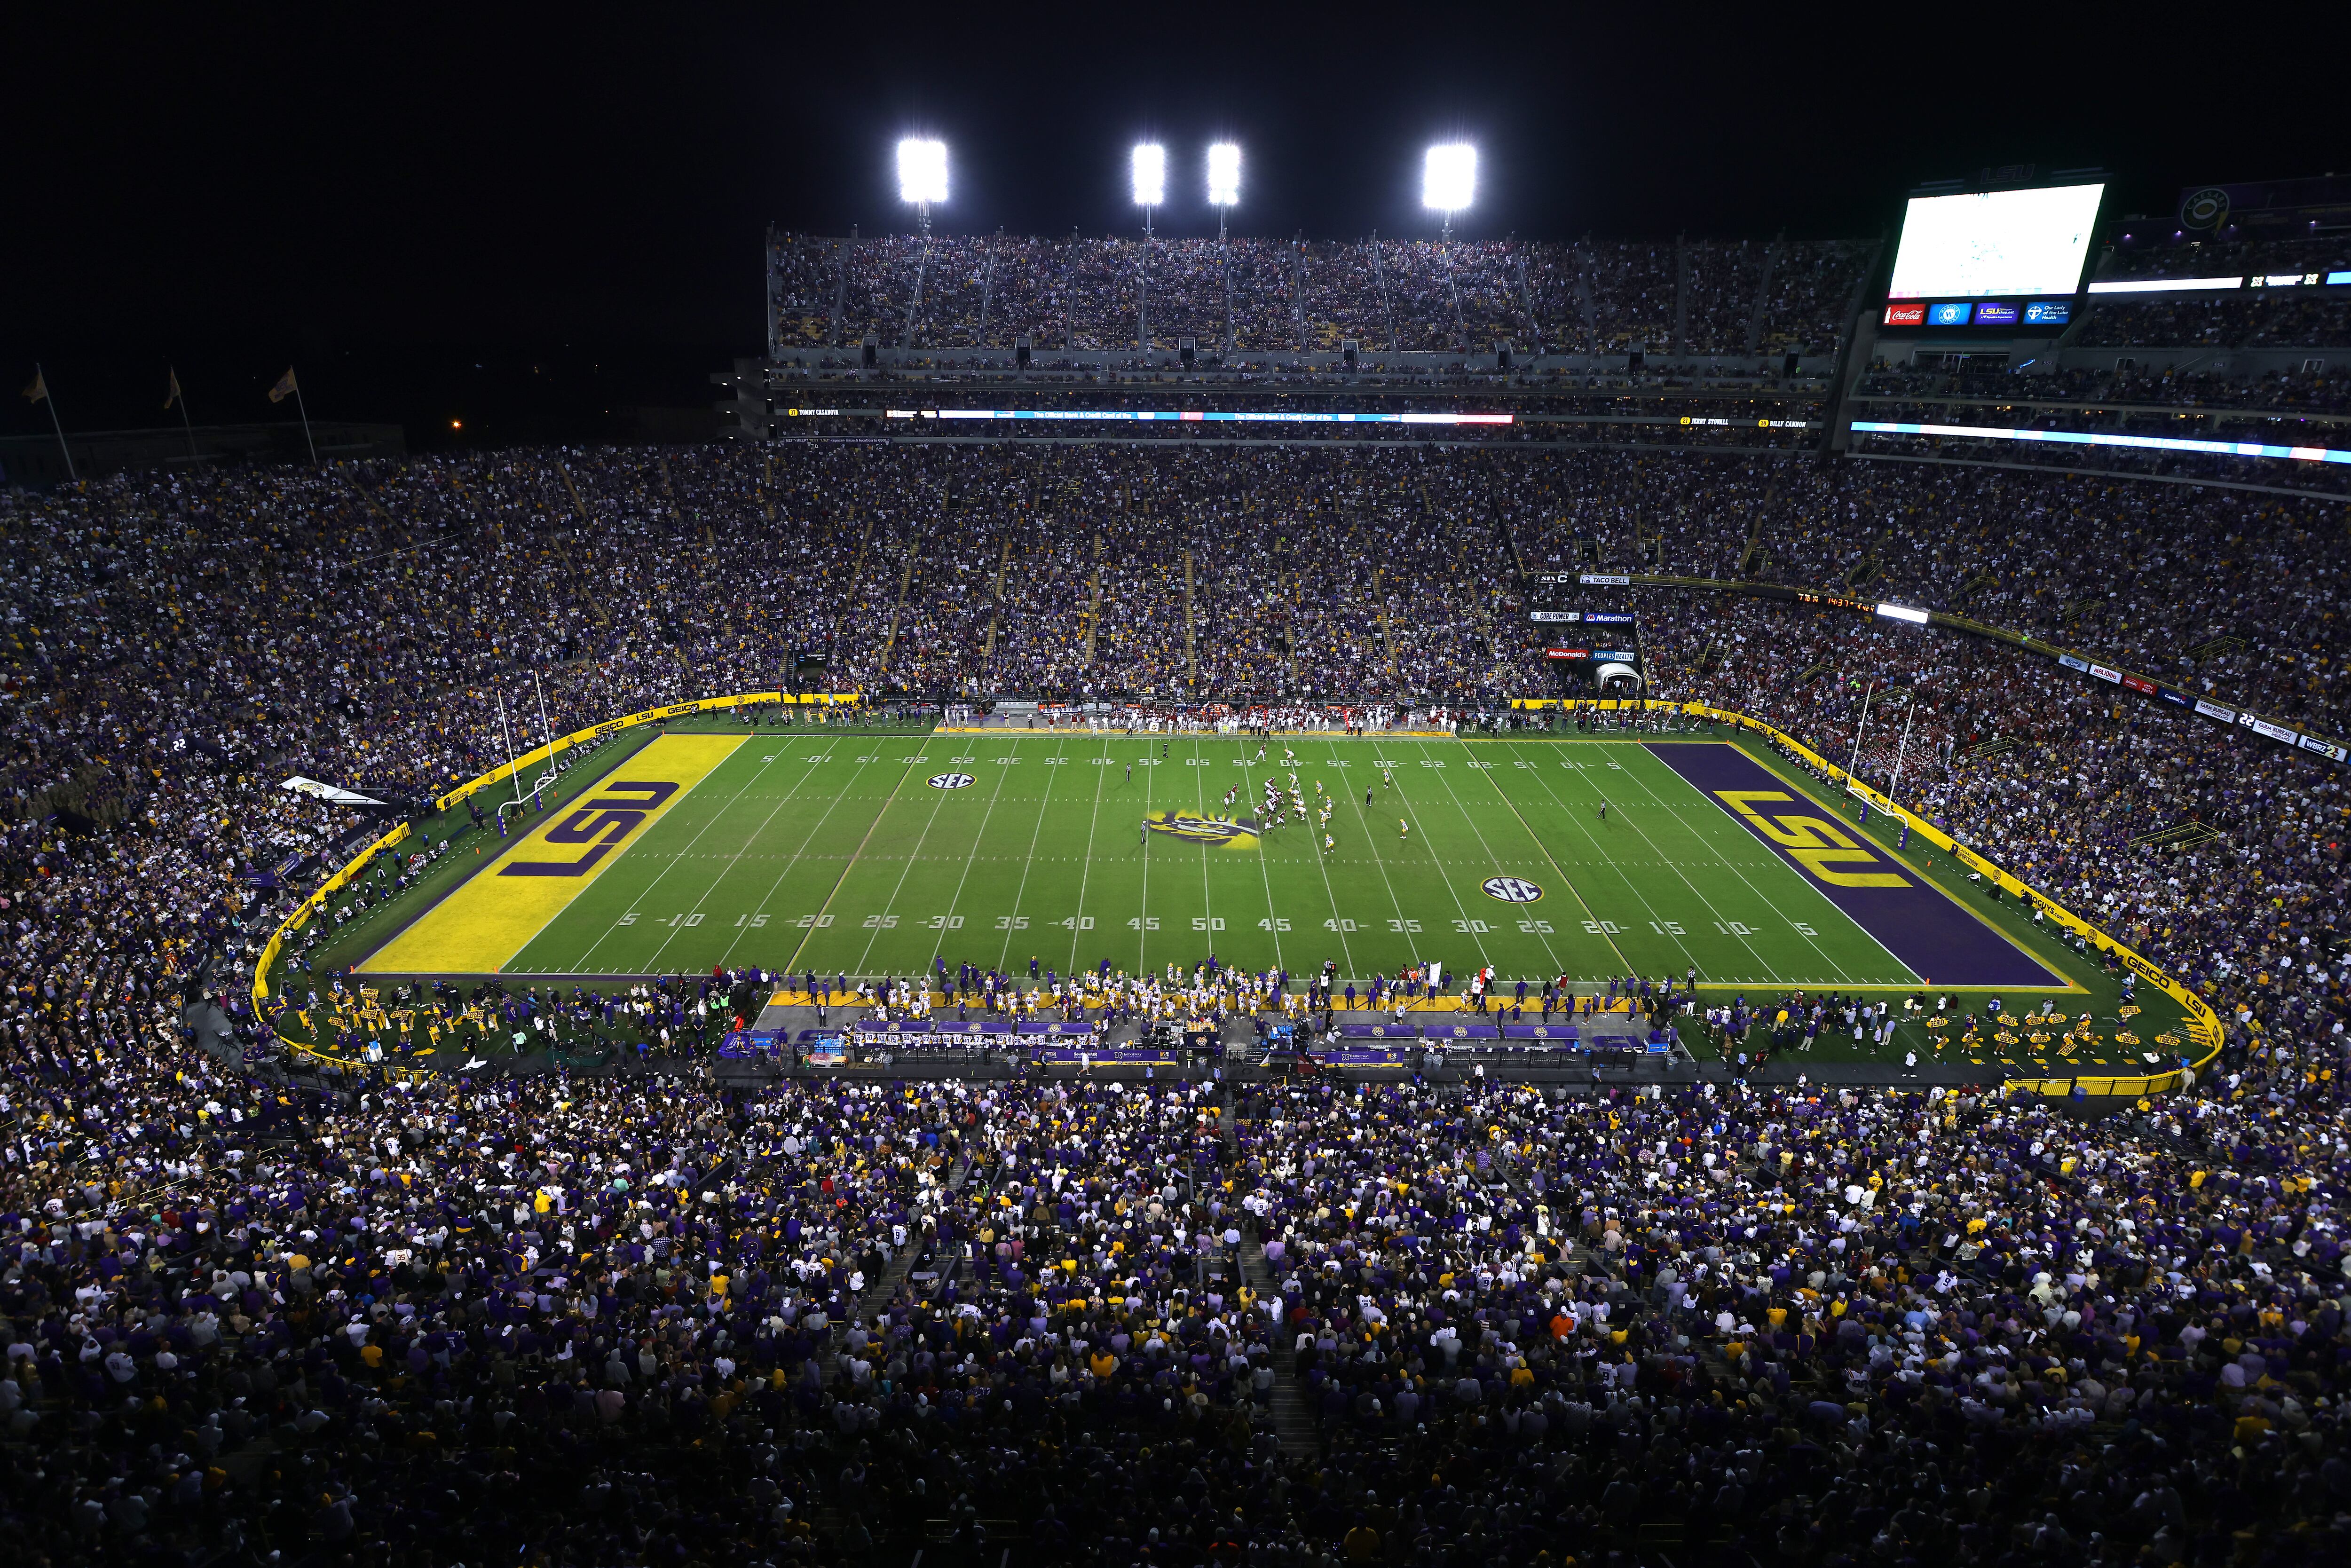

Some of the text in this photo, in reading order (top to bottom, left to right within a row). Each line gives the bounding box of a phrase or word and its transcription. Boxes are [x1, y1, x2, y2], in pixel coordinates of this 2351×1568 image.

[1981, 164, 2035, 184] LSU
[2186, 191, 2226, 210] CAESARS
[1893, 310, 1923, 321] Coca-Cola
[1940, 305, 1958, 314] HANCOCK
[1940, 314, 1958, 324] WHITNEY
[2067, 658, 2081, 668] Ford
[2103, 670, 2117, 679] JOHNS
[668, 703, 699, 715] GEICO
[2213, 707, 2231, 716] BUREAU
[636, 711, 654, 722] LSU
[2211, 712, 2229, 721] INSURANCE
[2239, 713, 2255, 726] 22
[595, 720, 624, 734] GEICO
[1754, 723, 1768, 733] LSU
[2258, 723, 2293, 737] FARM BUREAU
[2271, 733, 2290, 742] INSURANCE
[2306, 740, 2336, 758] WBRZ 2
[931, 773, 973, 788] SEC
[450, 790, 461, 799] CAESARS
[496, 781, 680, 877] LSU
[1712, 790, 1914, 887] LSU
[1959, 847, 1972, 858] CAESARS
[1957, 851, 1979, 868] SPORTSBOOK
[1485, 878, 1539, 902] SEC
[289, 900, 313, 926] SouthernAIR
[618, 913, 642, 926] 5
[668, 914, 706, 927] 10
[734, 914, 772, 927] 15
[796, 914, 836, 928] 20
[862, 915, 900, 928] 25
[928, 915, 965, 929] 30
[994, 916, 1030, 929] 35
[1061, 916, 1095, 930] 40
[1127, 917, 1160, 930] 45
[1192, 917, 1226, 931] 50
[1257, 918, 1292, 931] 45
[1323, 919, 1357, 932] 40
[1386, 919, 1423, 932] 35
[1451, 920, 1490, 933] 30
[1515, 920, 1555, 933] 25
[1580, 921, 1621, 934] 20
[1648, 921, 1687, 935] 15
[1713, 921, 1752, 935] 10
[1793, 922, 1819, 935] 5
[2127, 956, 2161, 989] GEICO
[2185, 994, 2206, 1018] LSU
[1930, 1018, 1946, 1027] GEAUX
[2002, 1017, 2016, 1026] GEAUX
[2051, 1014, 2063, 1023] GEAUX
[1997, 1034, 2016, 1044] TIGERS
[2120, 1034, 2138, 1044] TIGERS
[2158, 1035, 2178, 1045] TIGERS
[2060, 1043, 2077, 1056] TIGERS
[894, 1231, 900, 1240] 9
[1603, 1371, 1610, 1381] 9
